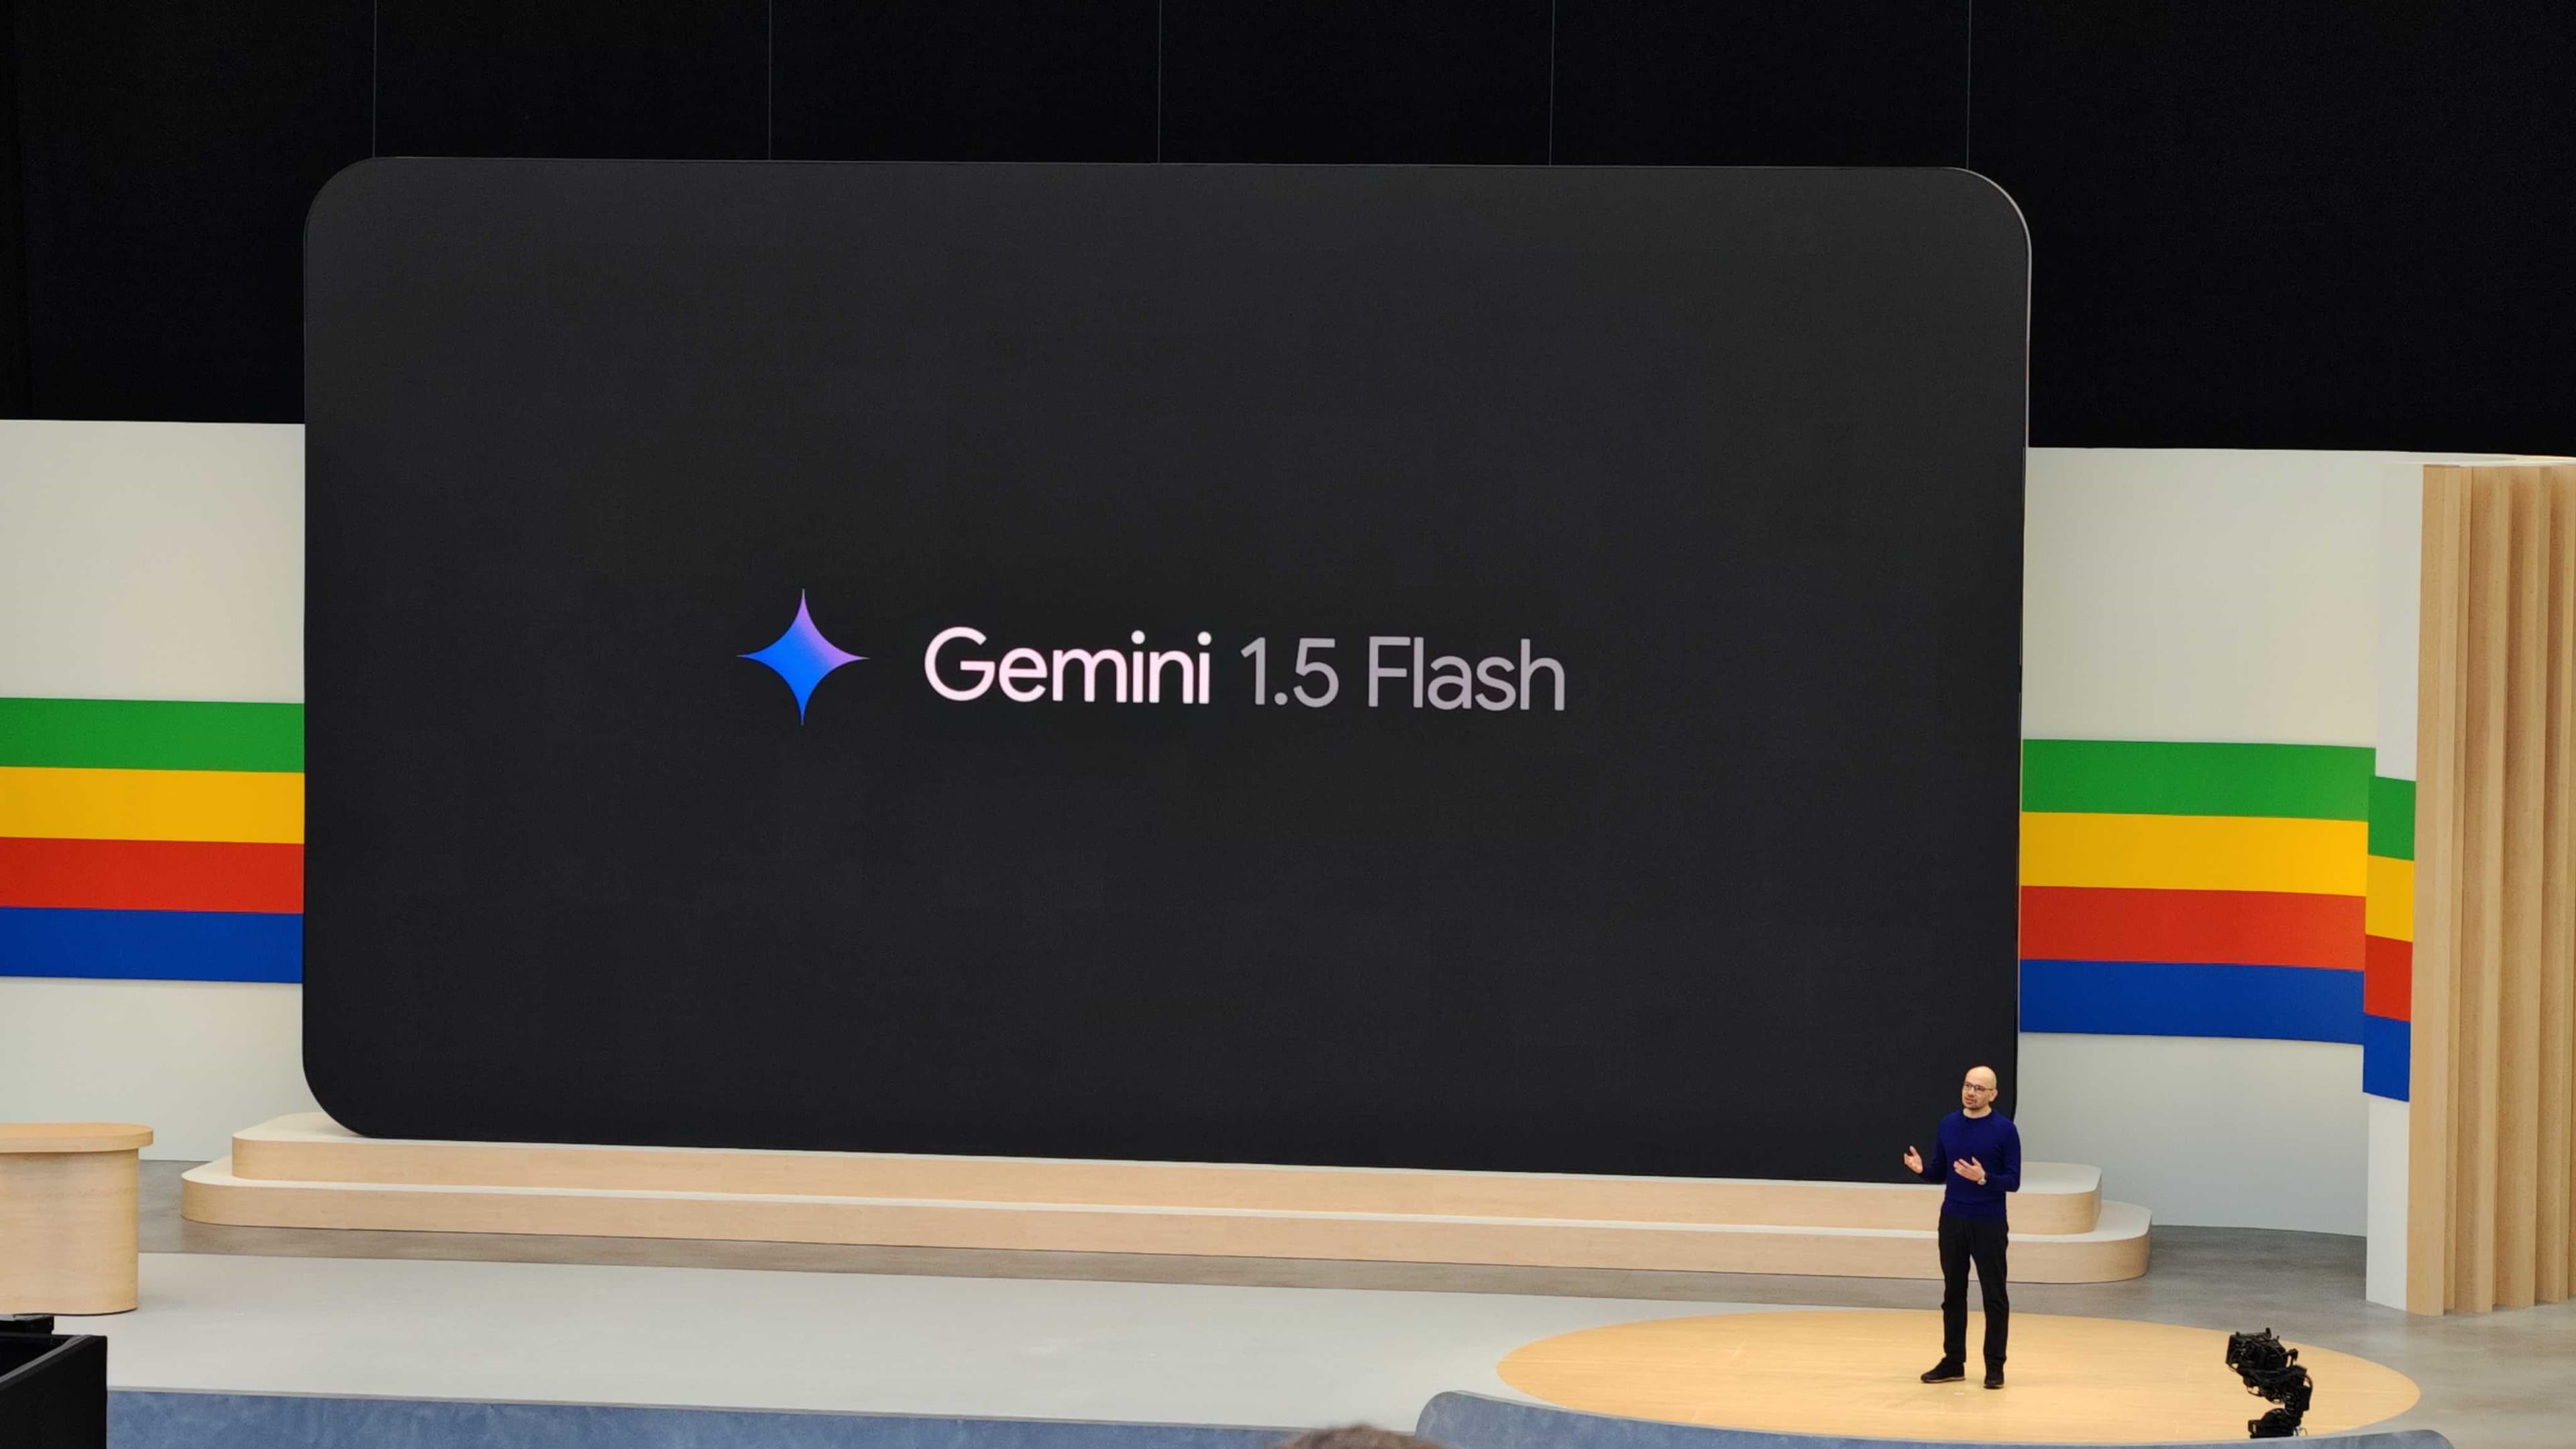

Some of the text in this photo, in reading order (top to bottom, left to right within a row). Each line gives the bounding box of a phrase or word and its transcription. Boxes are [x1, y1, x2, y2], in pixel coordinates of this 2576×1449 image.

[924, 626, 1565, 711] Gemini 1.5 Flash
